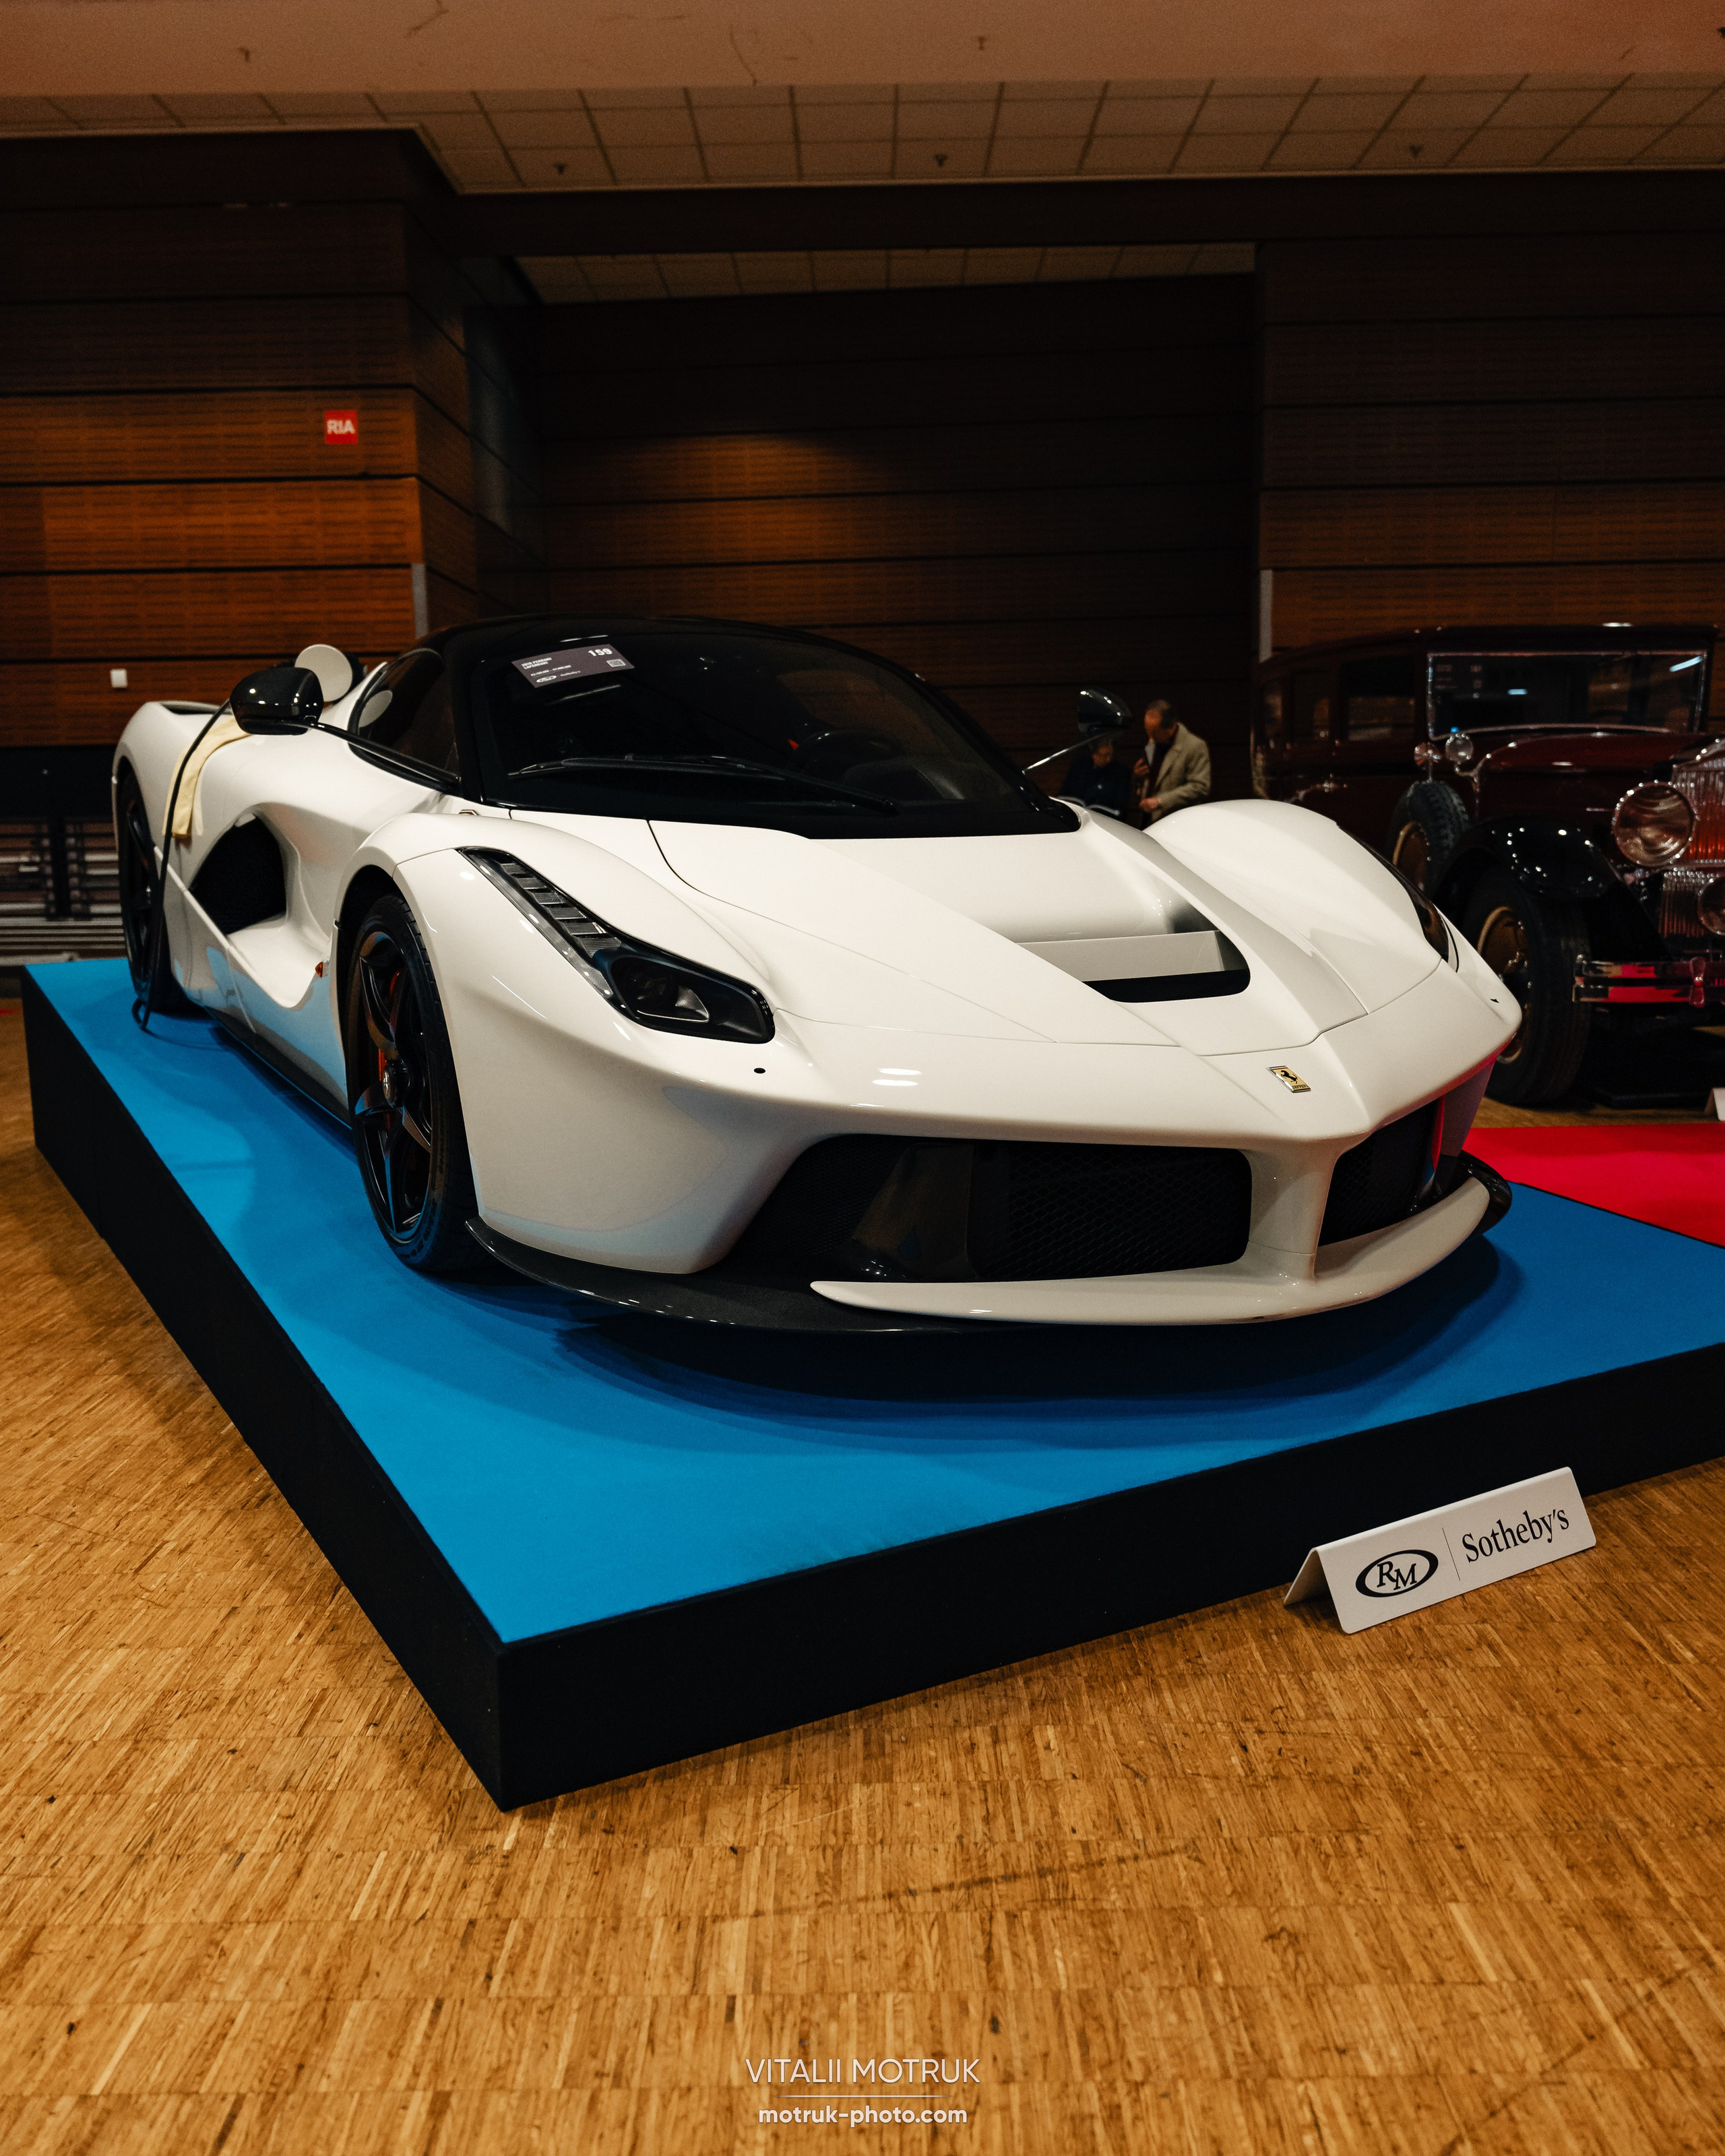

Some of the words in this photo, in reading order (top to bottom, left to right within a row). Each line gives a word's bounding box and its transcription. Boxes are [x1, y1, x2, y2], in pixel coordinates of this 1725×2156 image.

[327, 420, 355, 435] RIA
[588, 648, 613, 656] 159
[1377, 1560, 1418, 1591] RM
[1462, 1509, 1569, 1563] Sotheby's
